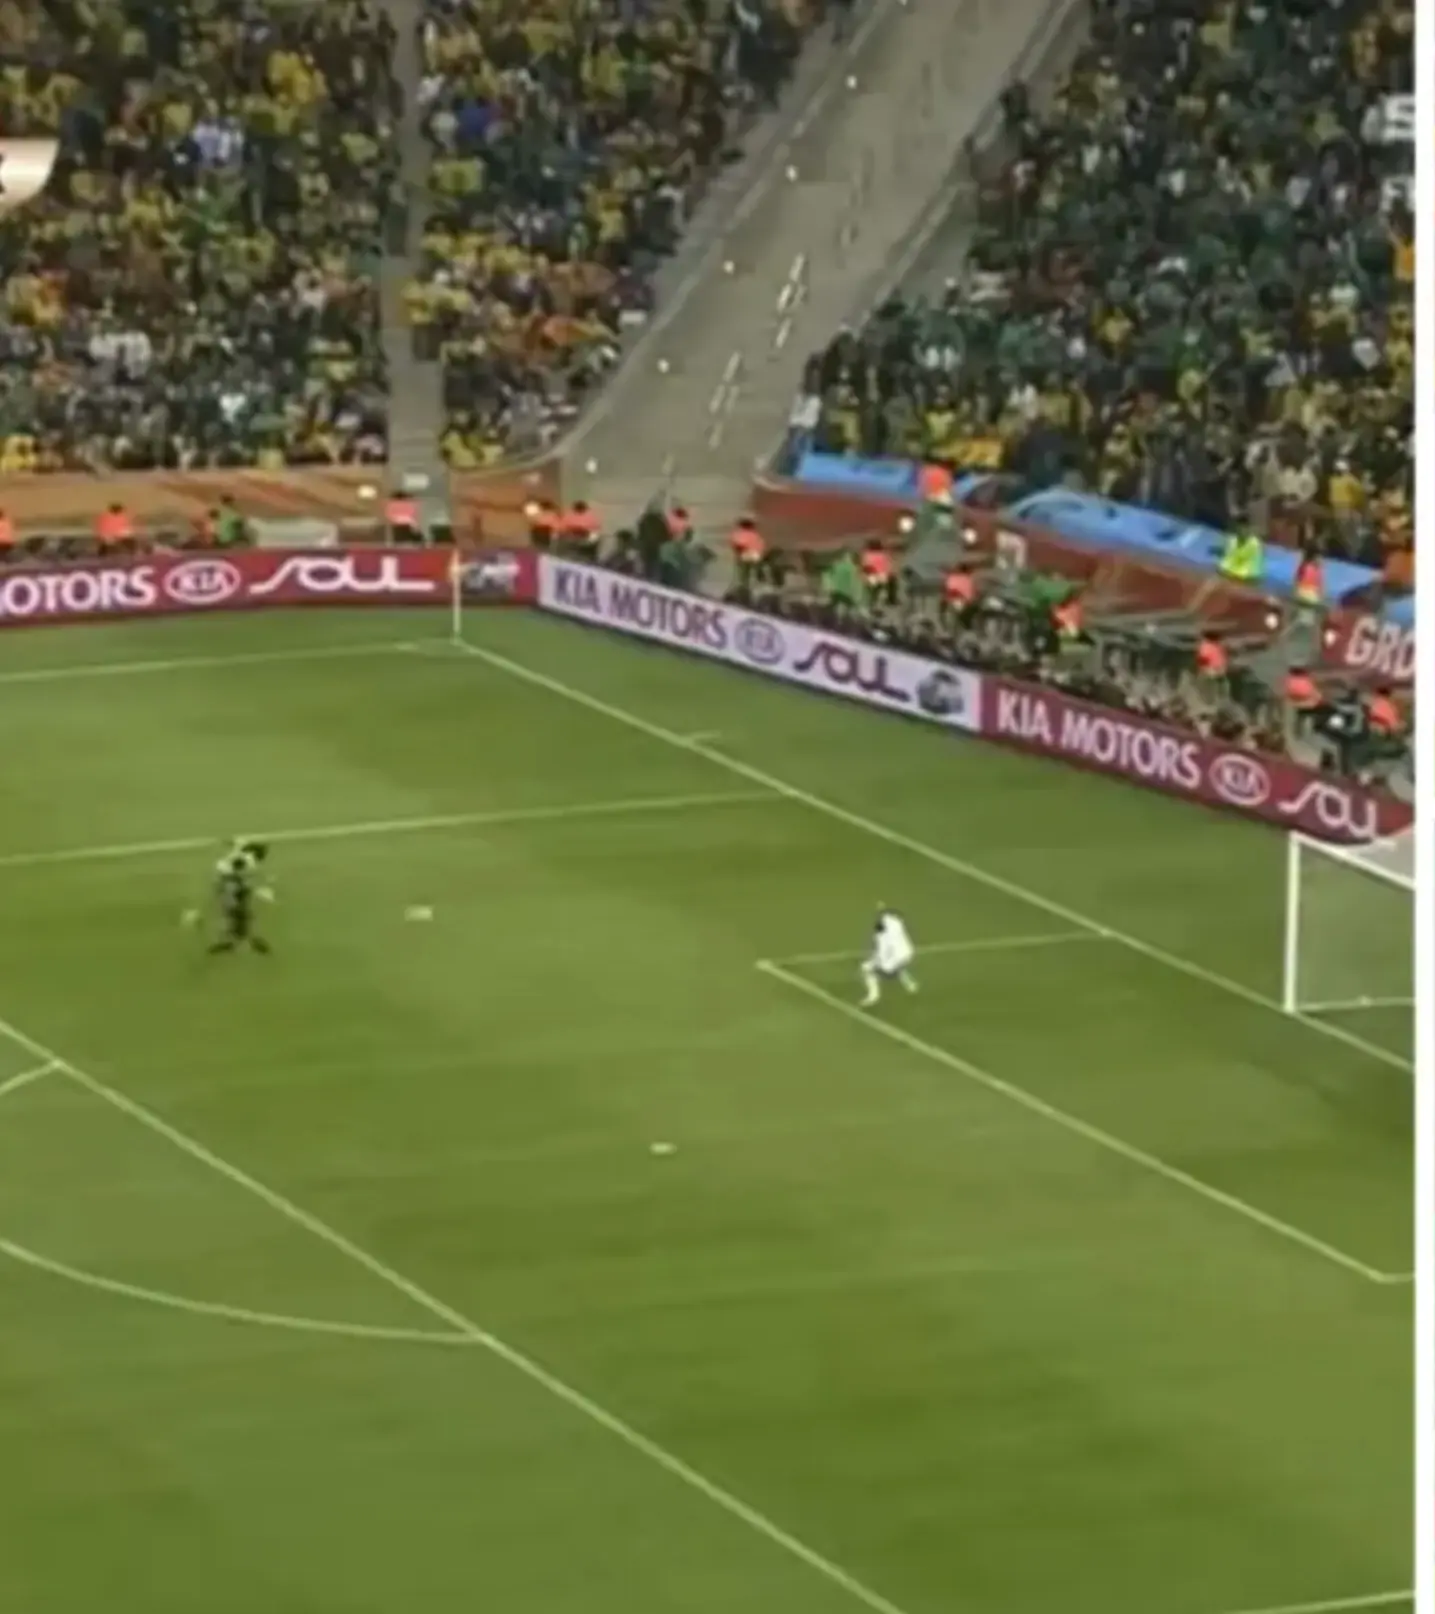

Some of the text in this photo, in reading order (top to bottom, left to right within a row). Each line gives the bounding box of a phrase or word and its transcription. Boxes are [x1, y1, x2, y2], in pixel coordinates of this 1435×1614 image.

[0, 565, 158, 617] OTORS
[249, 555, 436, 594] SOUL
[555, 568, 728, 650] KIA MOTORS
[997, 688, 1202, 789] KIA MOTORS
